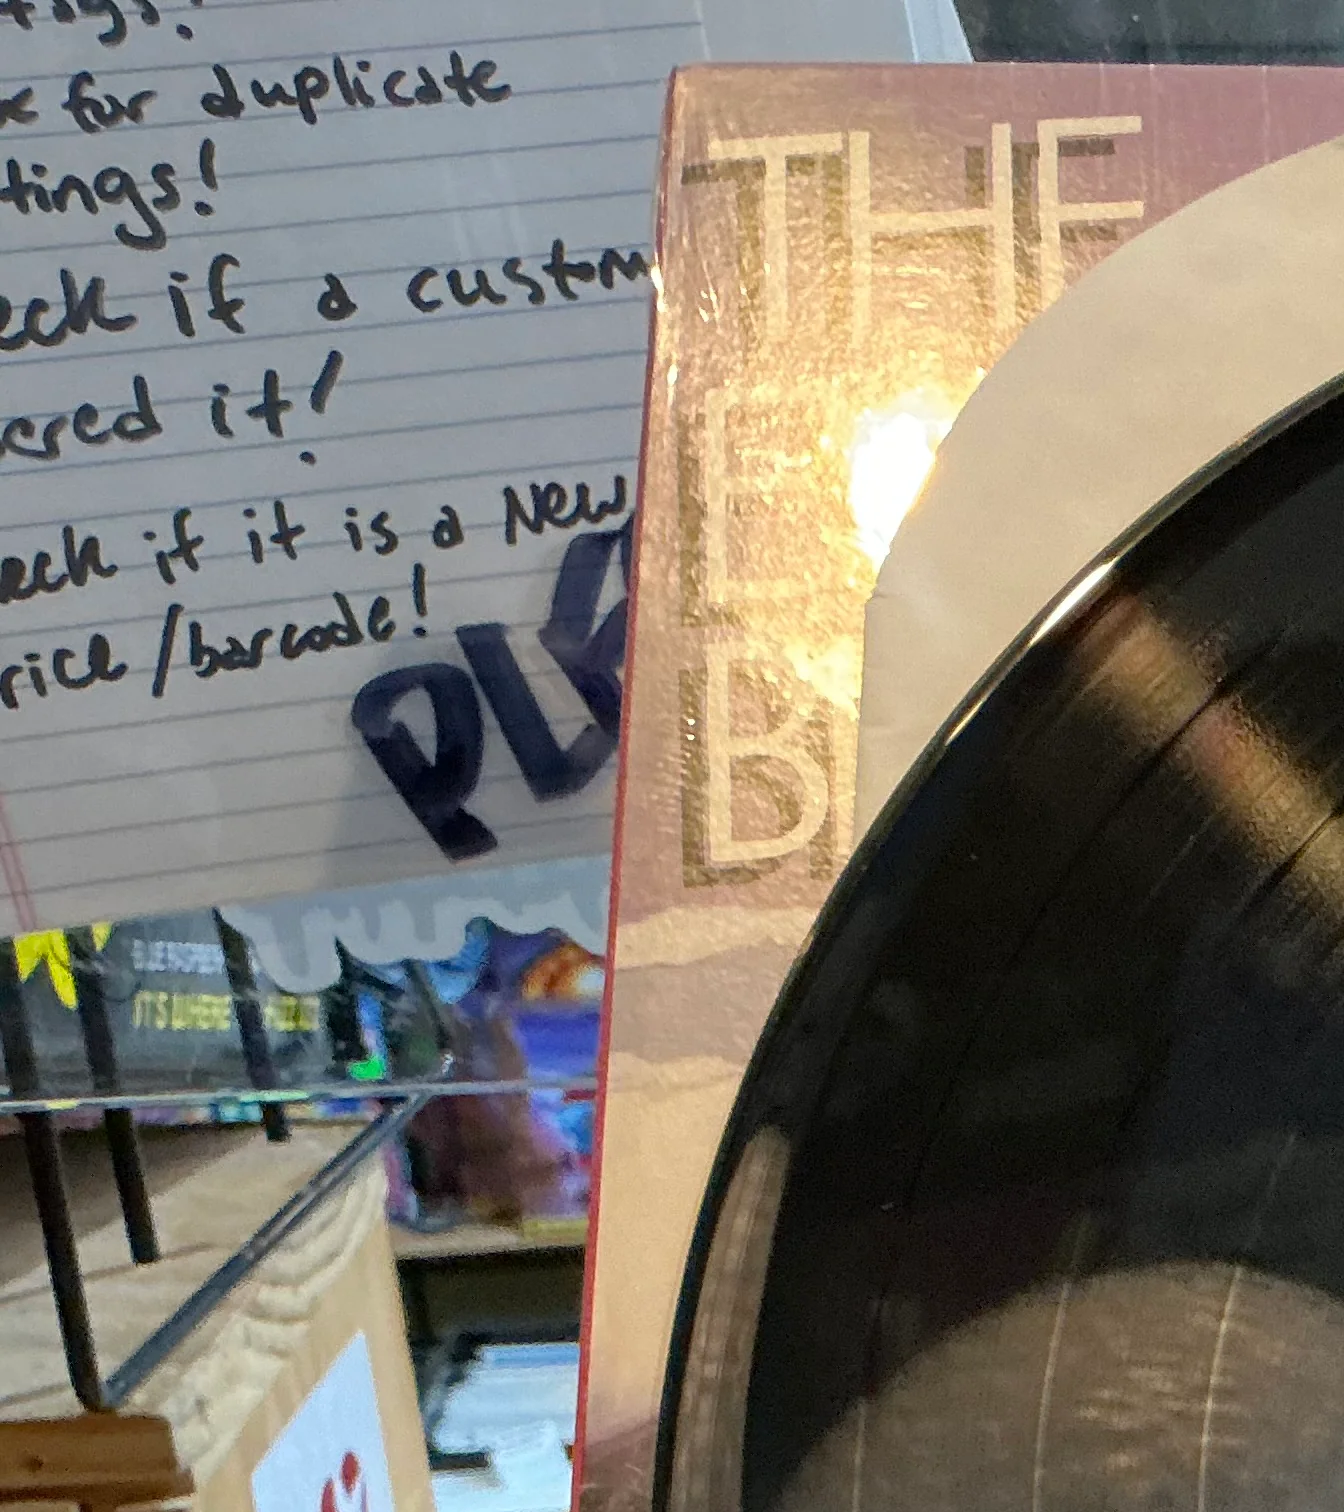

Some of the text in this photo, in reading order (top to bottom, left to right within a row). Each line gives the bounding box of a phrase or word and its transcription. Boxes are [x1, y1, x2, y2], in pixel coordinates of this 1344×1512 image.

[61, 71, 158, 133] for
[200, 51, 511, 125] duplicate
[168, 253, 245, 334] if
[317, 272, 357, 321] a
[210, 350, 344, 465] it!
[143, 509, 204, 584] if
[244, 501, 304, 565] it
[344, 508, 398, 554] is
[432, 505, 464, 548] a
[503, 475, 626, 545] New
